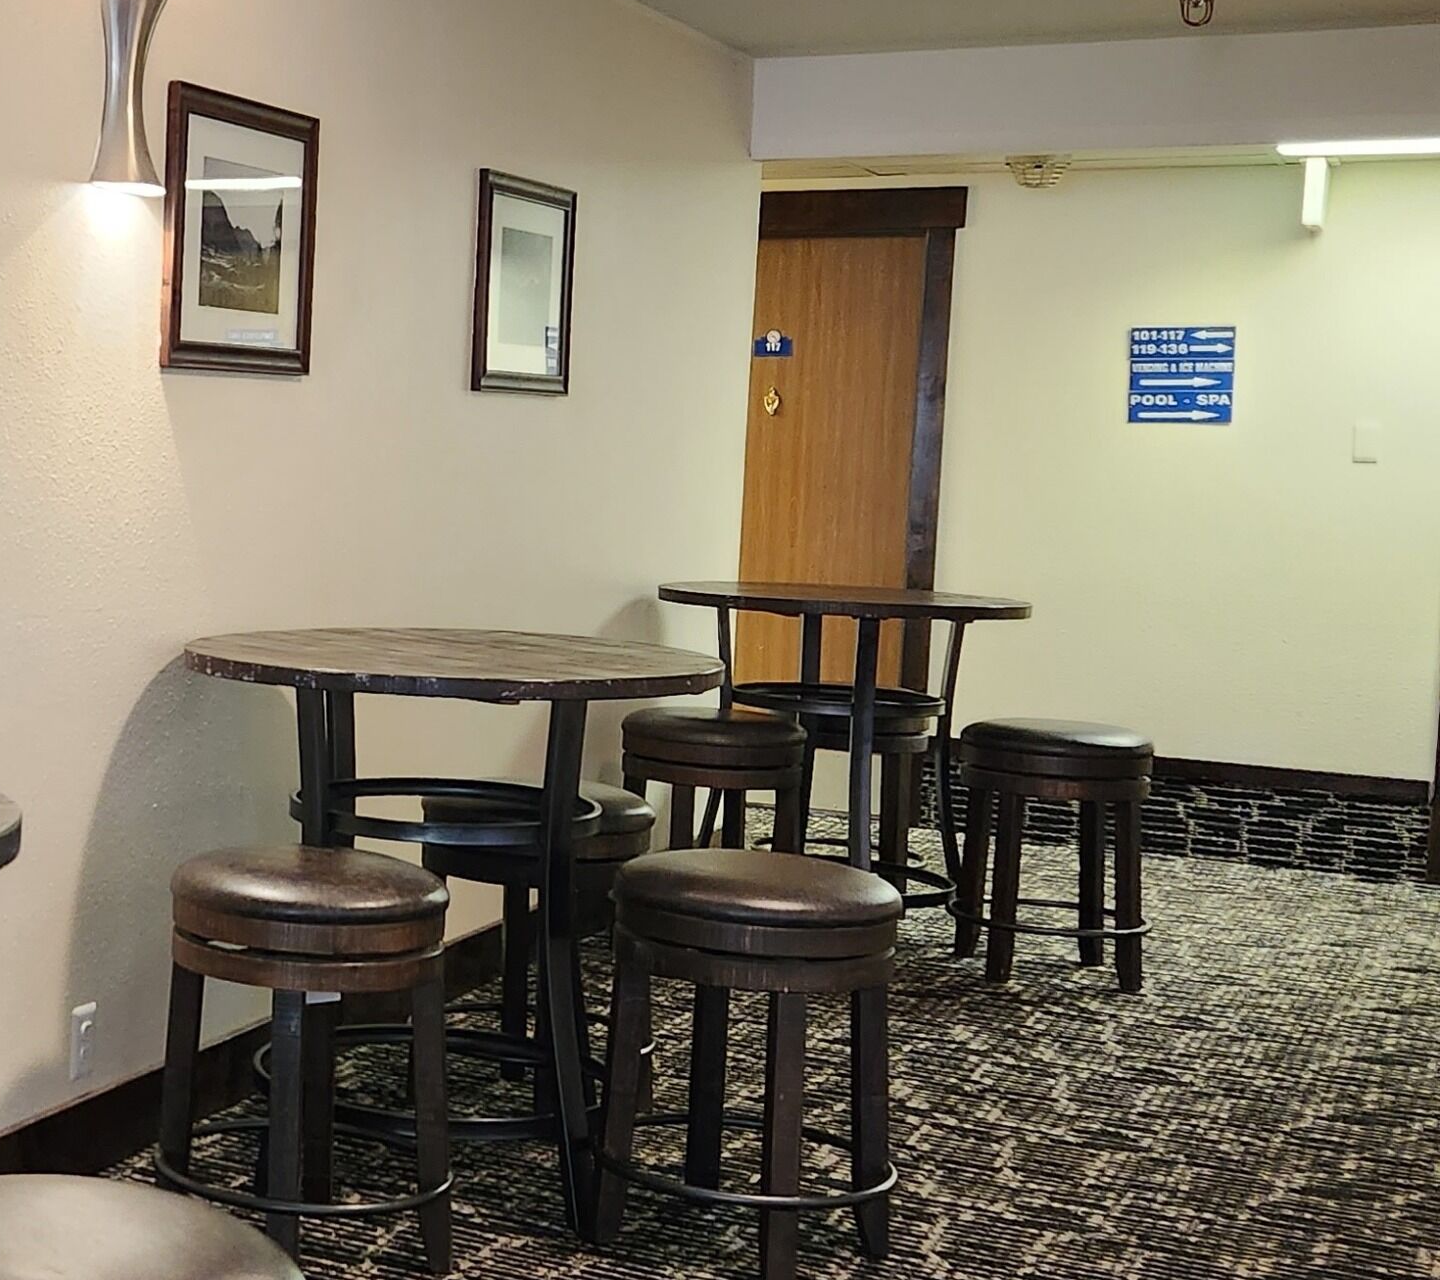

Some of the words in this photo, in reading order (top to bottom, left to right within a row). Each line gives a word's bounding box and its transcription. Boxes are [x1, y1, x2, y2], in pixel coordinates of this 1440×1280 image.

[1132, 330, 1185, 341] 101-117
[766, 342, 781, 352] 117
[1131, 343, 1188, 354] 119-136
[1130, 394, 1178, 405] POOL
[1196, 394, 1231, 406] SPA
